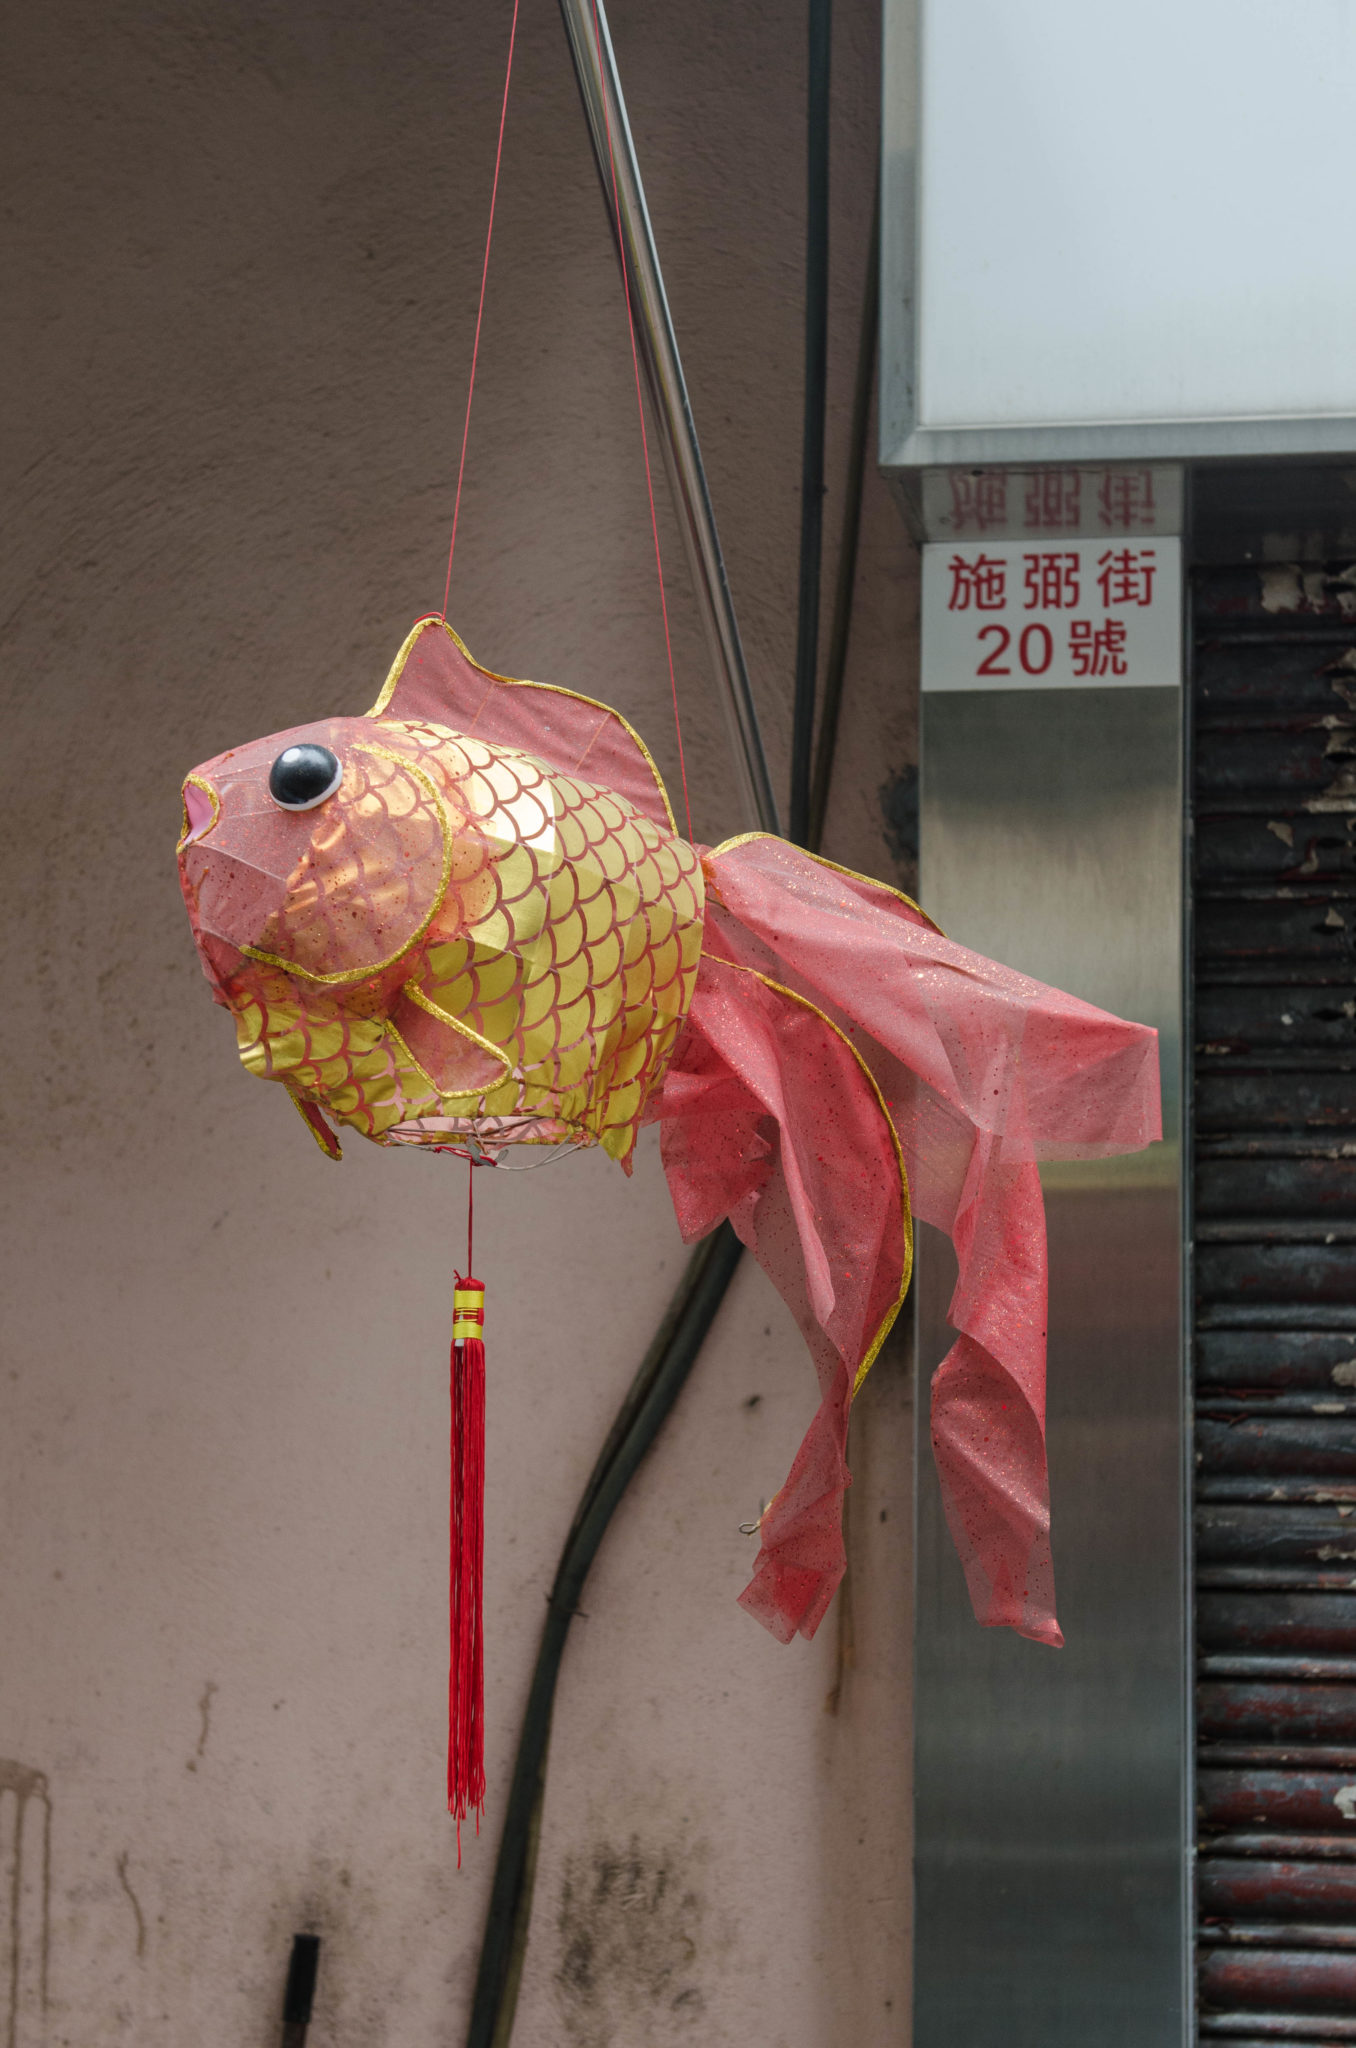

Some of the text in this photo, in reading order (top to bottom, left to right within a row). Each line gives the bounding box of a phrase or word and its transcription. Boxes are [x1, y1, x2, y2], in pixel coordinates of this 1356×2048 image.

[948, 549, 1156, 611] 施弼街
[975, 618, 1128, 676] 20號
